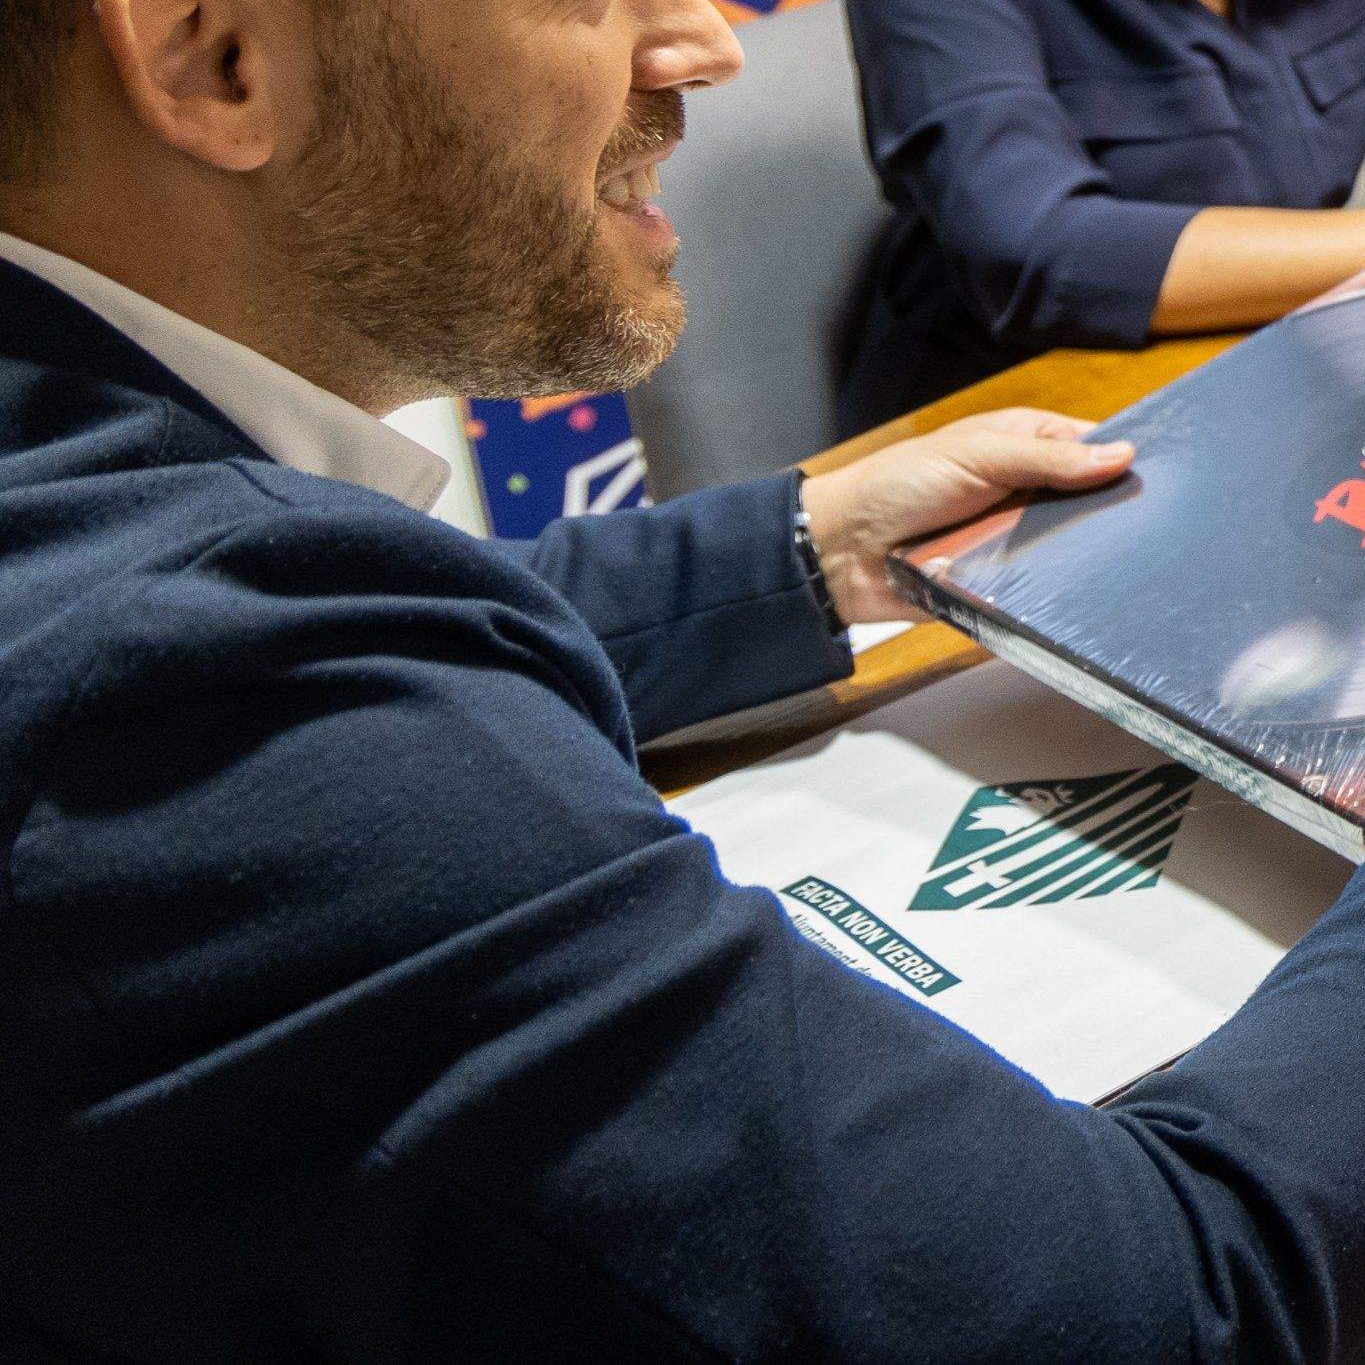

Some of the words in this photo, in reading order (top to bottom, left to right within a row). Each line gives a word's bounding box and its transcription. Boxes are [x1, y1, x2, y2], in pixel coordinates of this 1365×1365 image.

[790, 881, 851, 917] FACTA
[837, 910, 890, 945] NON
[876, 938, 944, 989] VERBA
